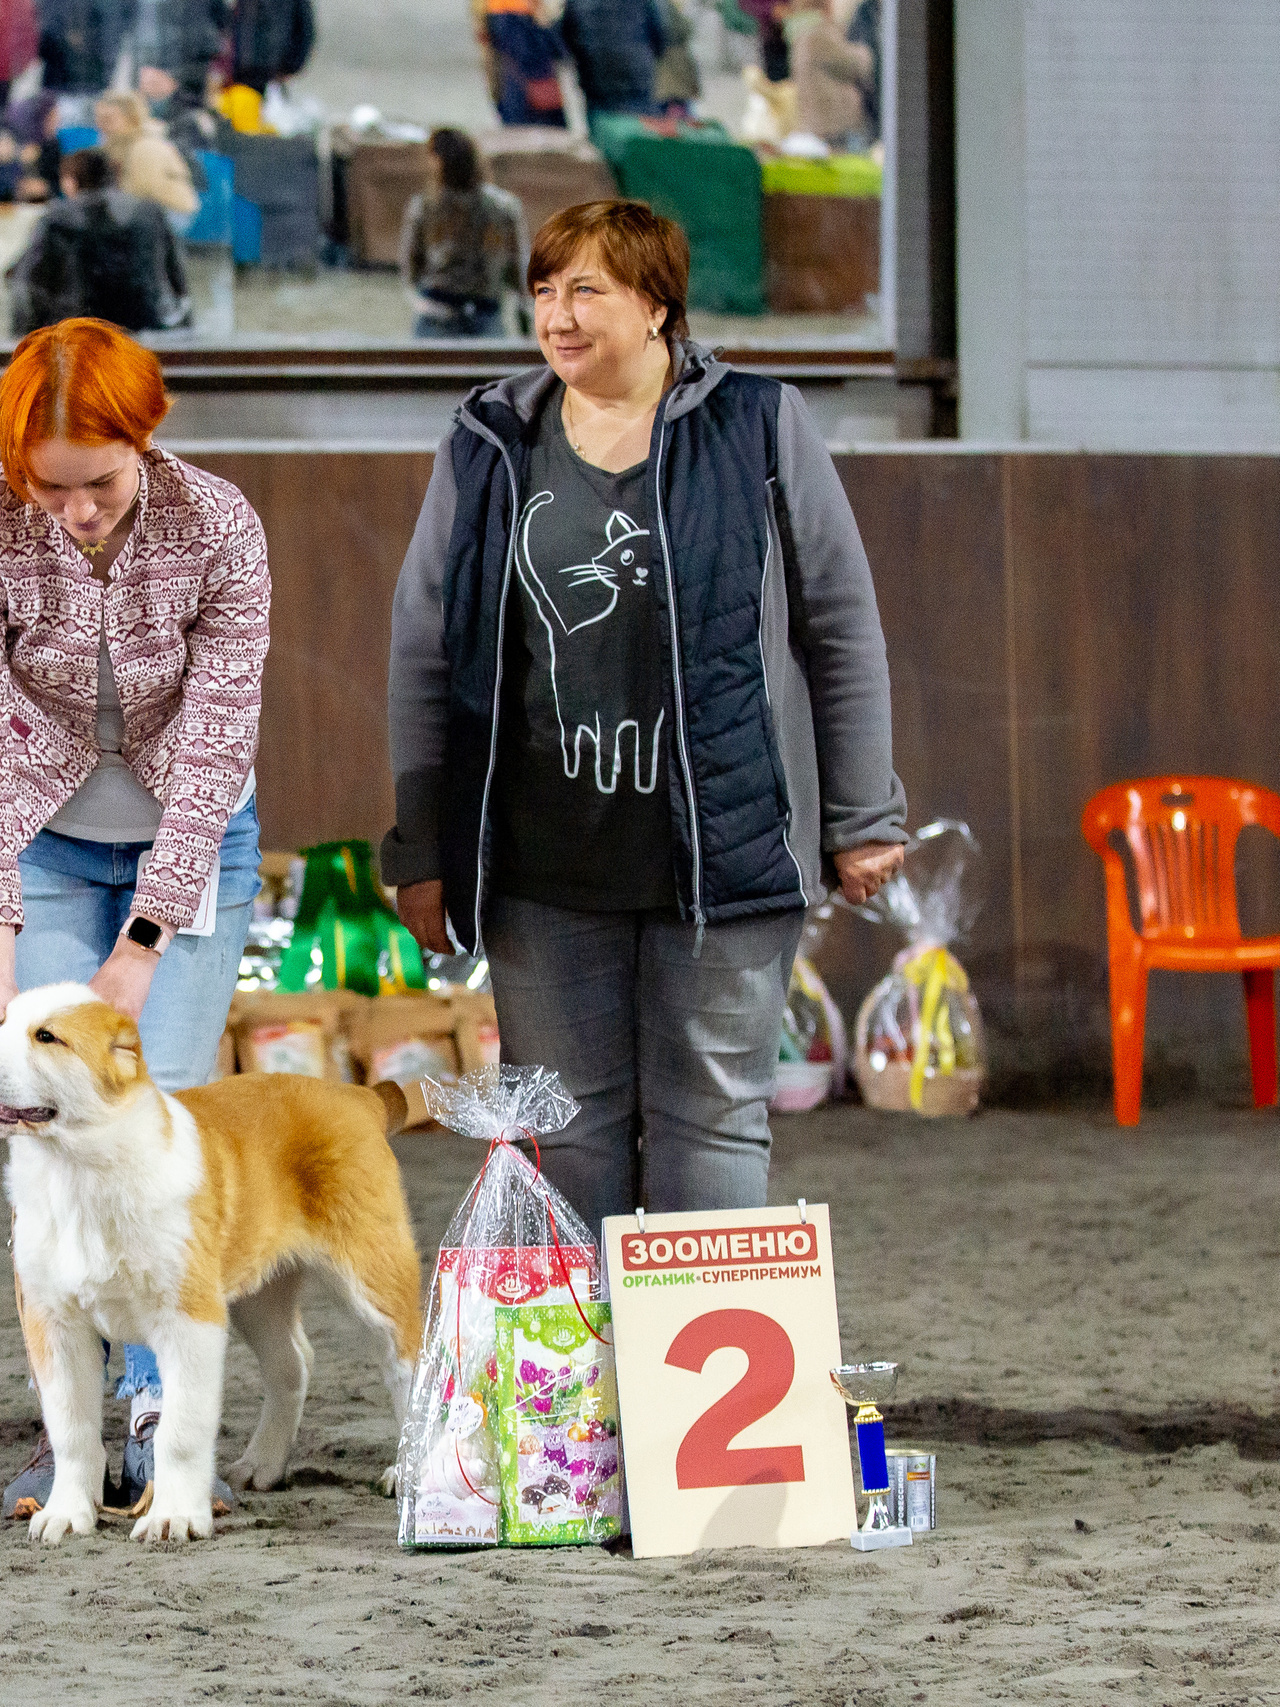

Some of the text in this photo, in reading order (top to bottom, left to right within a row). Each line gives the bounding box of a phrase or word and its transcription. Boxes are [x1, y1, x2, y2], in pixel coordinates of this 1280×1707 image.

[627, 1229, 812, 1265] ЗООМЕНЮ
[702, 1265, 822, 1284] СУПЕРПРЕМИУМ
[664, 1308, 806, 1490] 2
